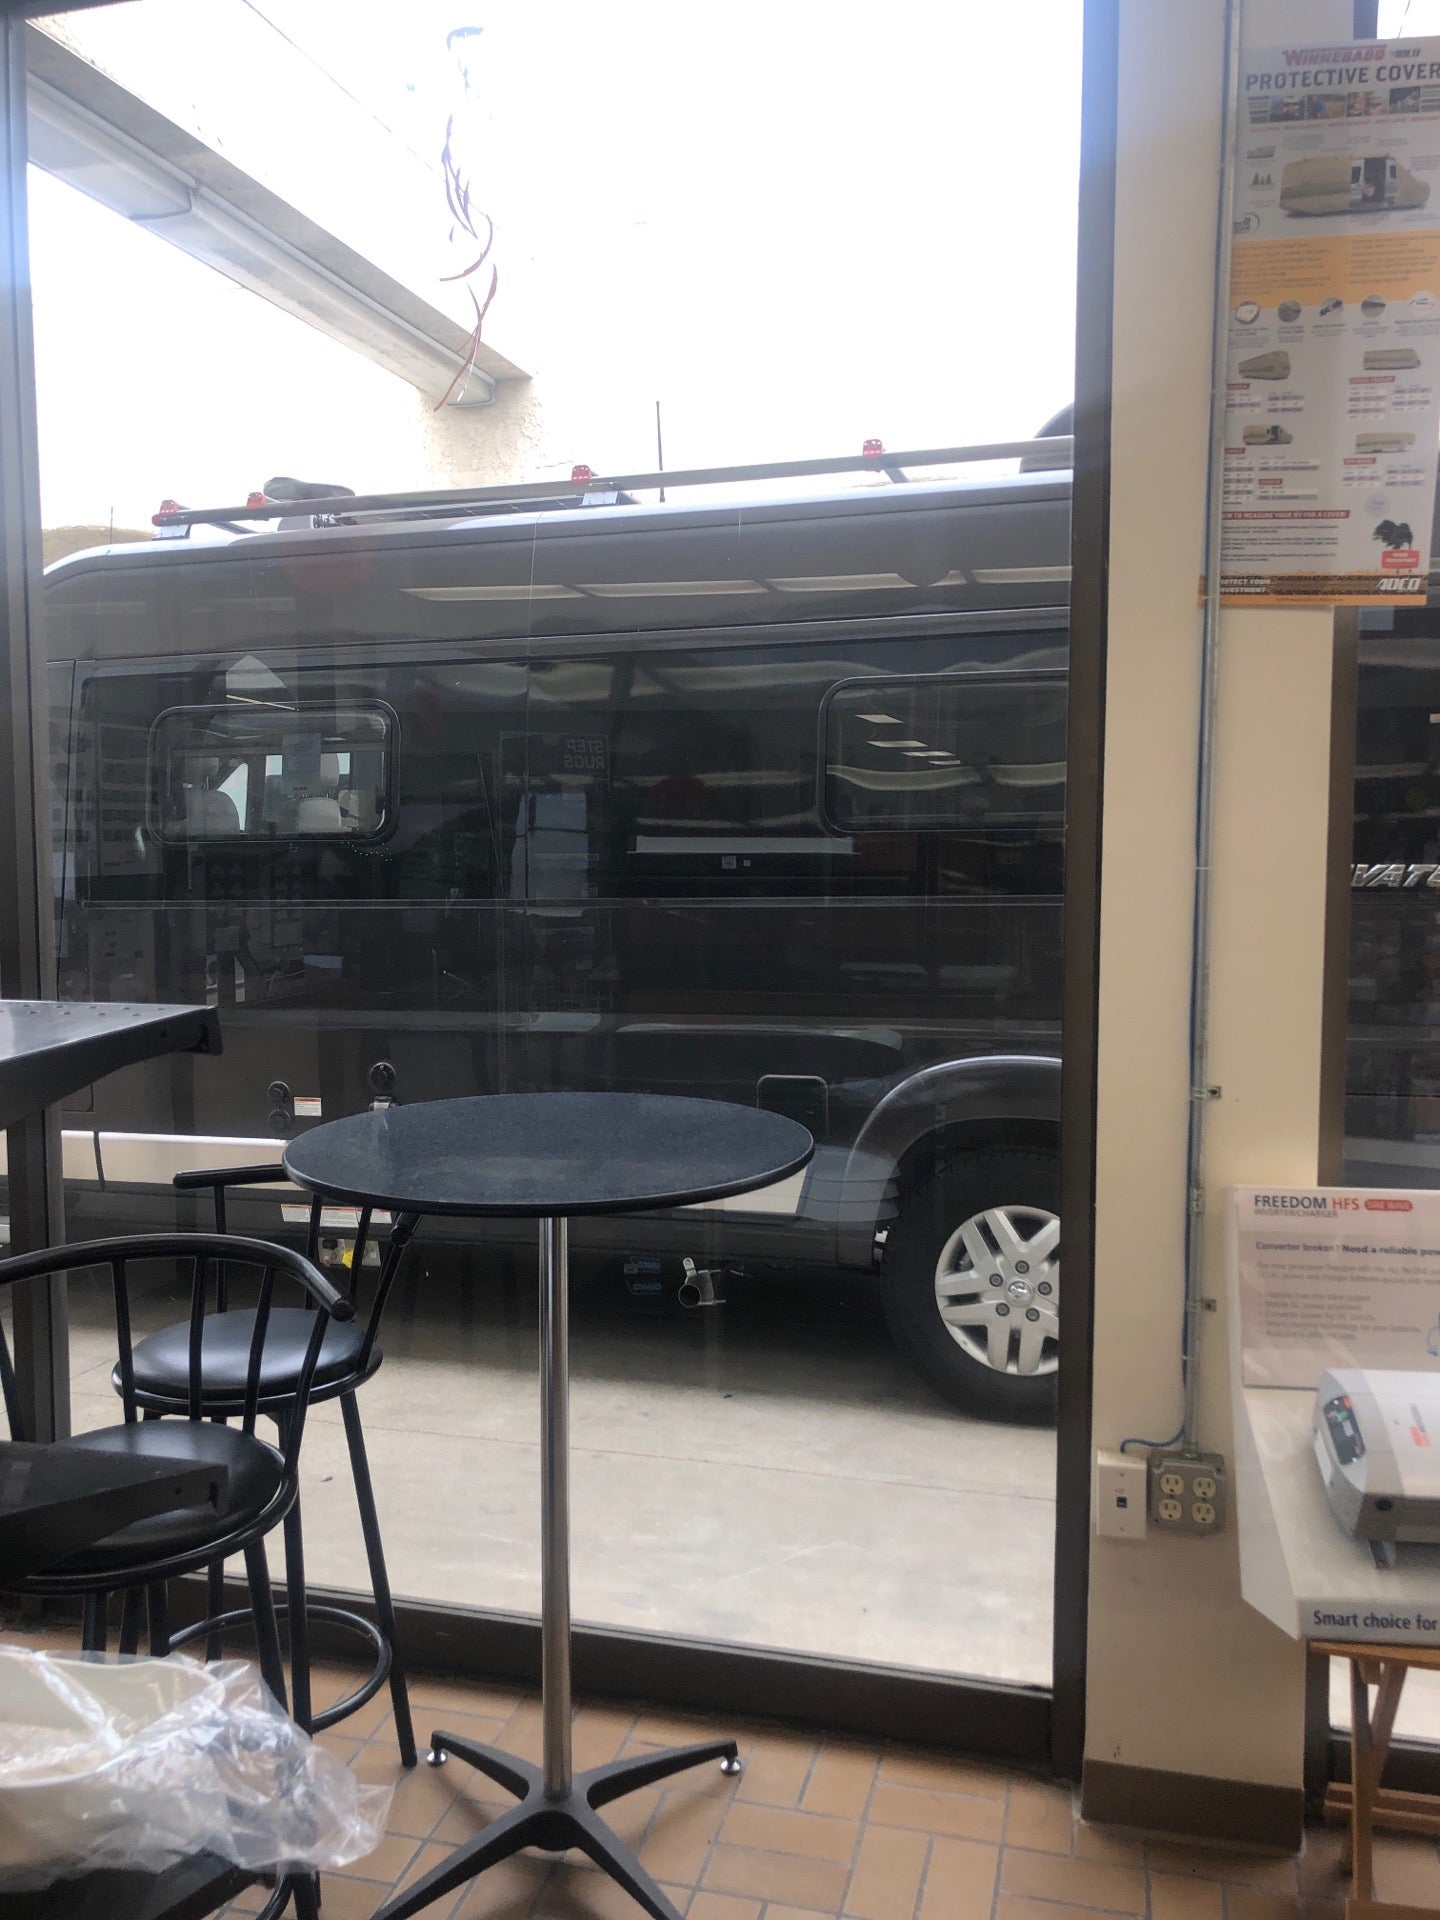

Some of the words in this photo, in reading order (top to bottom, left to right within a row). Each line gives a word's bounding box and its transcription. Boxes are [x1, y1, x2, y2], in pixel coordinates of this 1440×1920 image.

[1246, 66, 1369, 91] PROTECTIVE
[1375, 62, 1440, 83] COVER
[1376, 577, 1420, 591] ADCO
[1254, 1195, 1327, 1209] FREEDOM
[1332, 1198, 1359, 1211] HFS
[1256, 1241, 1300, 1251] Converter
[1342, 1244, 1368, 1254] Need
[1379, 1245, 1418, 1256] reliable
[1313, 1609, 1360, 1628] Smart
[1362, 1611, 1412, 1630] choice
[1416, 1613, 1438, 1631] for
